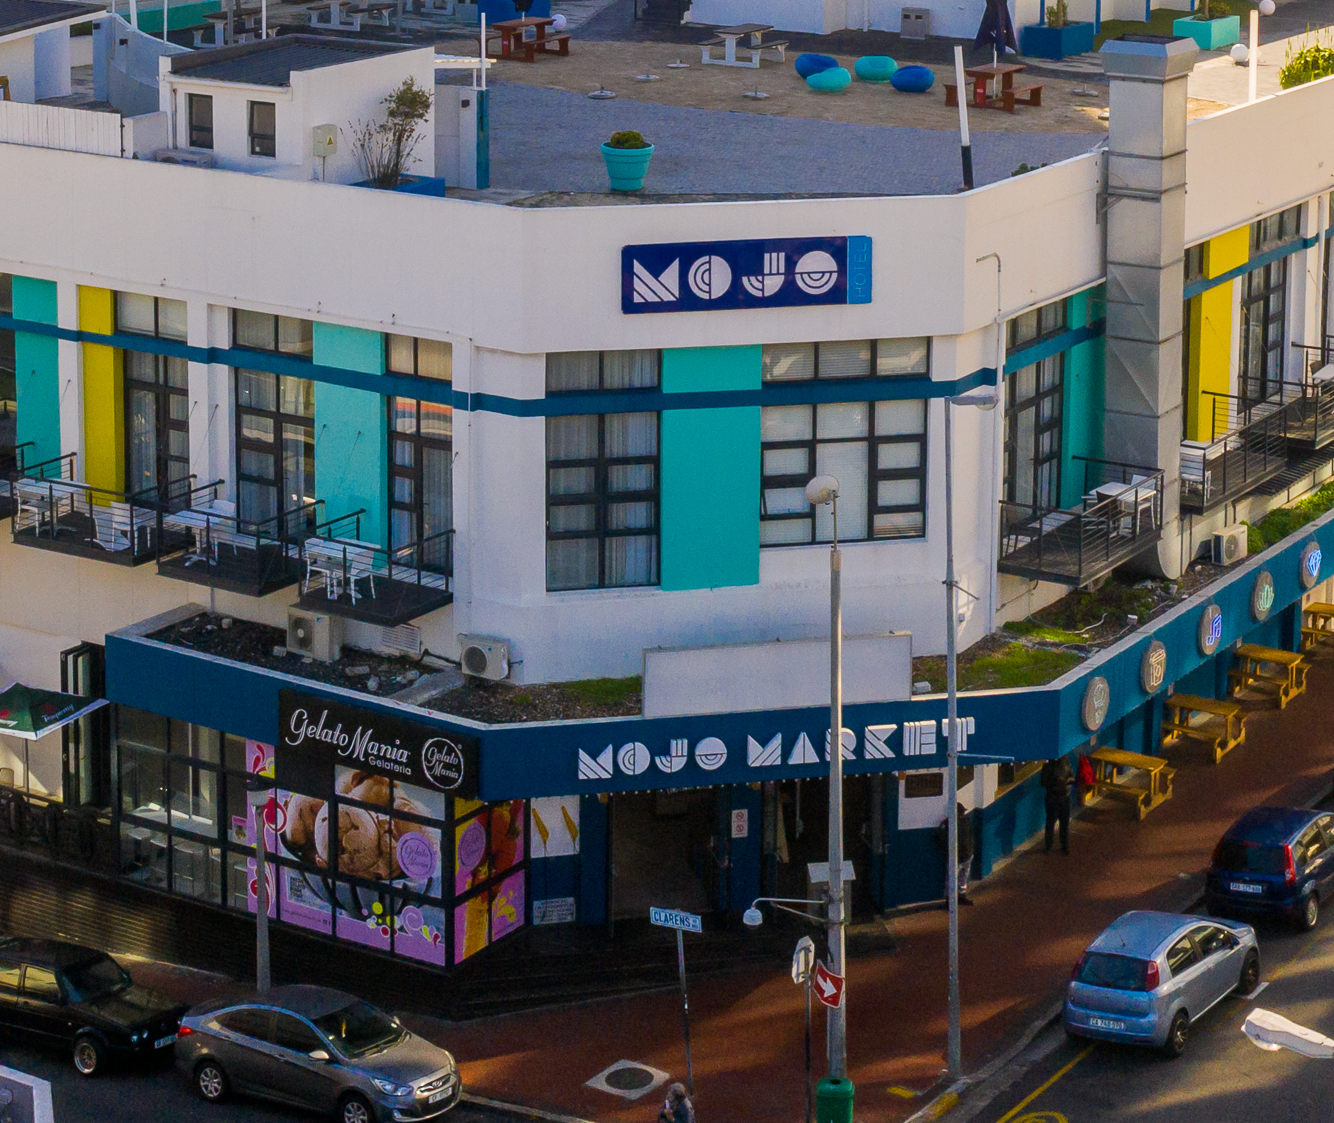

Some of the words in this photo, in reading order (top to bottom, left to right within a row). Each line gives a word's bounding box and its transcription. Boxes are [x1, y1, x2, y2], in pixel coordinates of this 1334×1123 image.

[633, 249, 839, 304] MOJO
[853, 241, 868, 299] HOTEL
[285, 708, 349, 746] Gelato
[337, 726, 411, 762] Mania
[578, 736, 728, 780] MOJO
[746, 716, 976, 768] MARKET
[368, 755, 412, 776] Gelateria
[425, 744, 459, 767] Gelato
[428, 764, 459, 780] Mania
[653, 910, 691, 927] CLARENS
